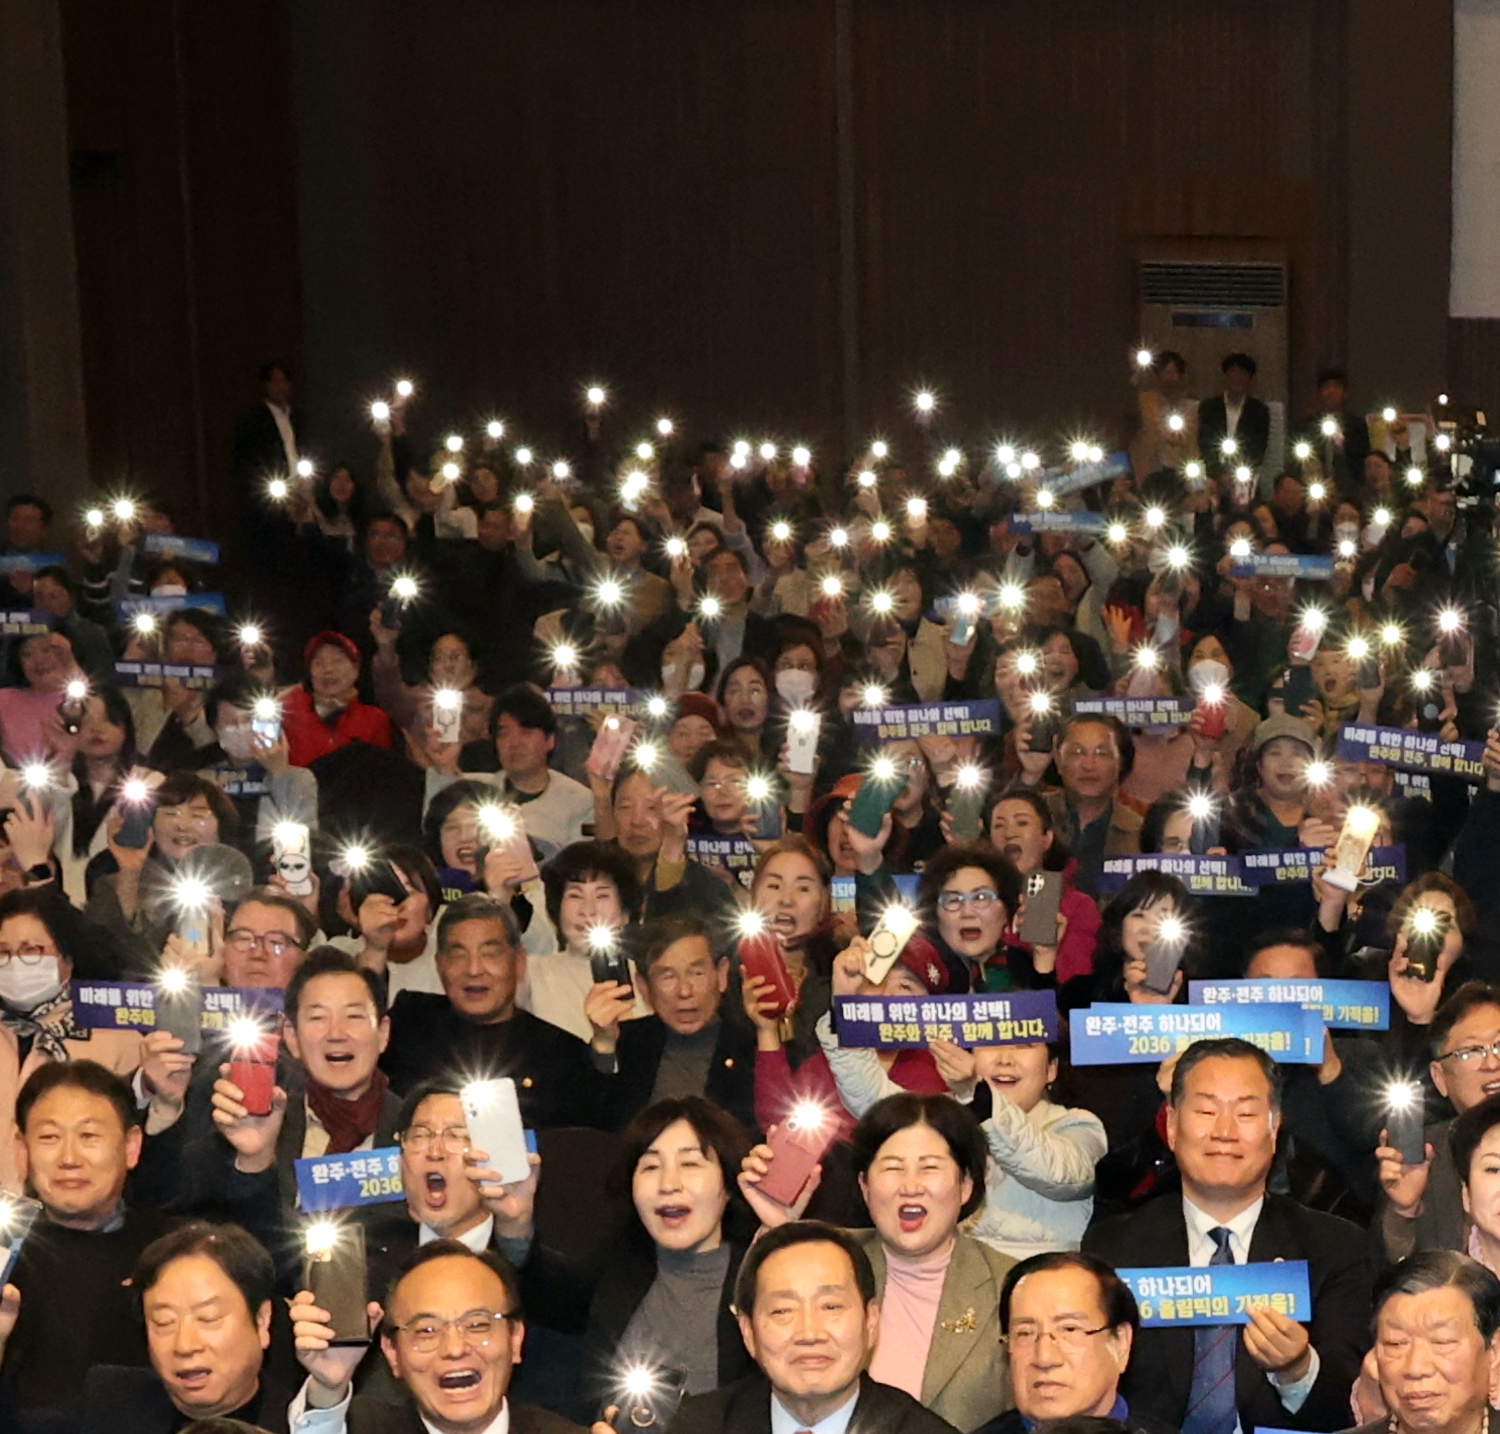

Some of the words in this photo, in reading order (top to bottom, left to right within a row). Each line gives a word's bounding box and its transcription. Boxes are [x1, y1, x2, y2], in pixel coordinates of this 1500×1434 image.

[1404, 733, 1436, 751] 하나의
[79, 987, 120, 1006] 미래를
[125, 988, 153, 1008] 위한
[204, 992, 241, 1010] 선택!
[1203, 986, 1264, 1004] 완주·전주
[1268, 985, 1323, 1003] 하나되어
[842, 1003, 883, 1022] 미래를
[888, 1003, 917, 1021] 위한
[921, 1002, 966, 1021] 하나의
[972, 1001, 1010, 1020] 선택!
[1333, 1006, 1379, 1024] 기적을!
[879, 1023, 920, 1041] 완주와
[961, 1021, 993, 1039] 함께
[998, 1019, 1047, 1038] 합니다.
[1085, 1013, 1154, 1036] 완주·전주
[1159, 1011, 1220, 1032] 하나되어
[1128, 1036, 1171, 1055] 2036
[311, 1160, 383, 1184] 완주·전주
[359, 1177, 402, 1198] 2036
[1138, 1274, 1212, 1294] 하나되어
[1159, 1295, 1229, 1318] 올림픽의
